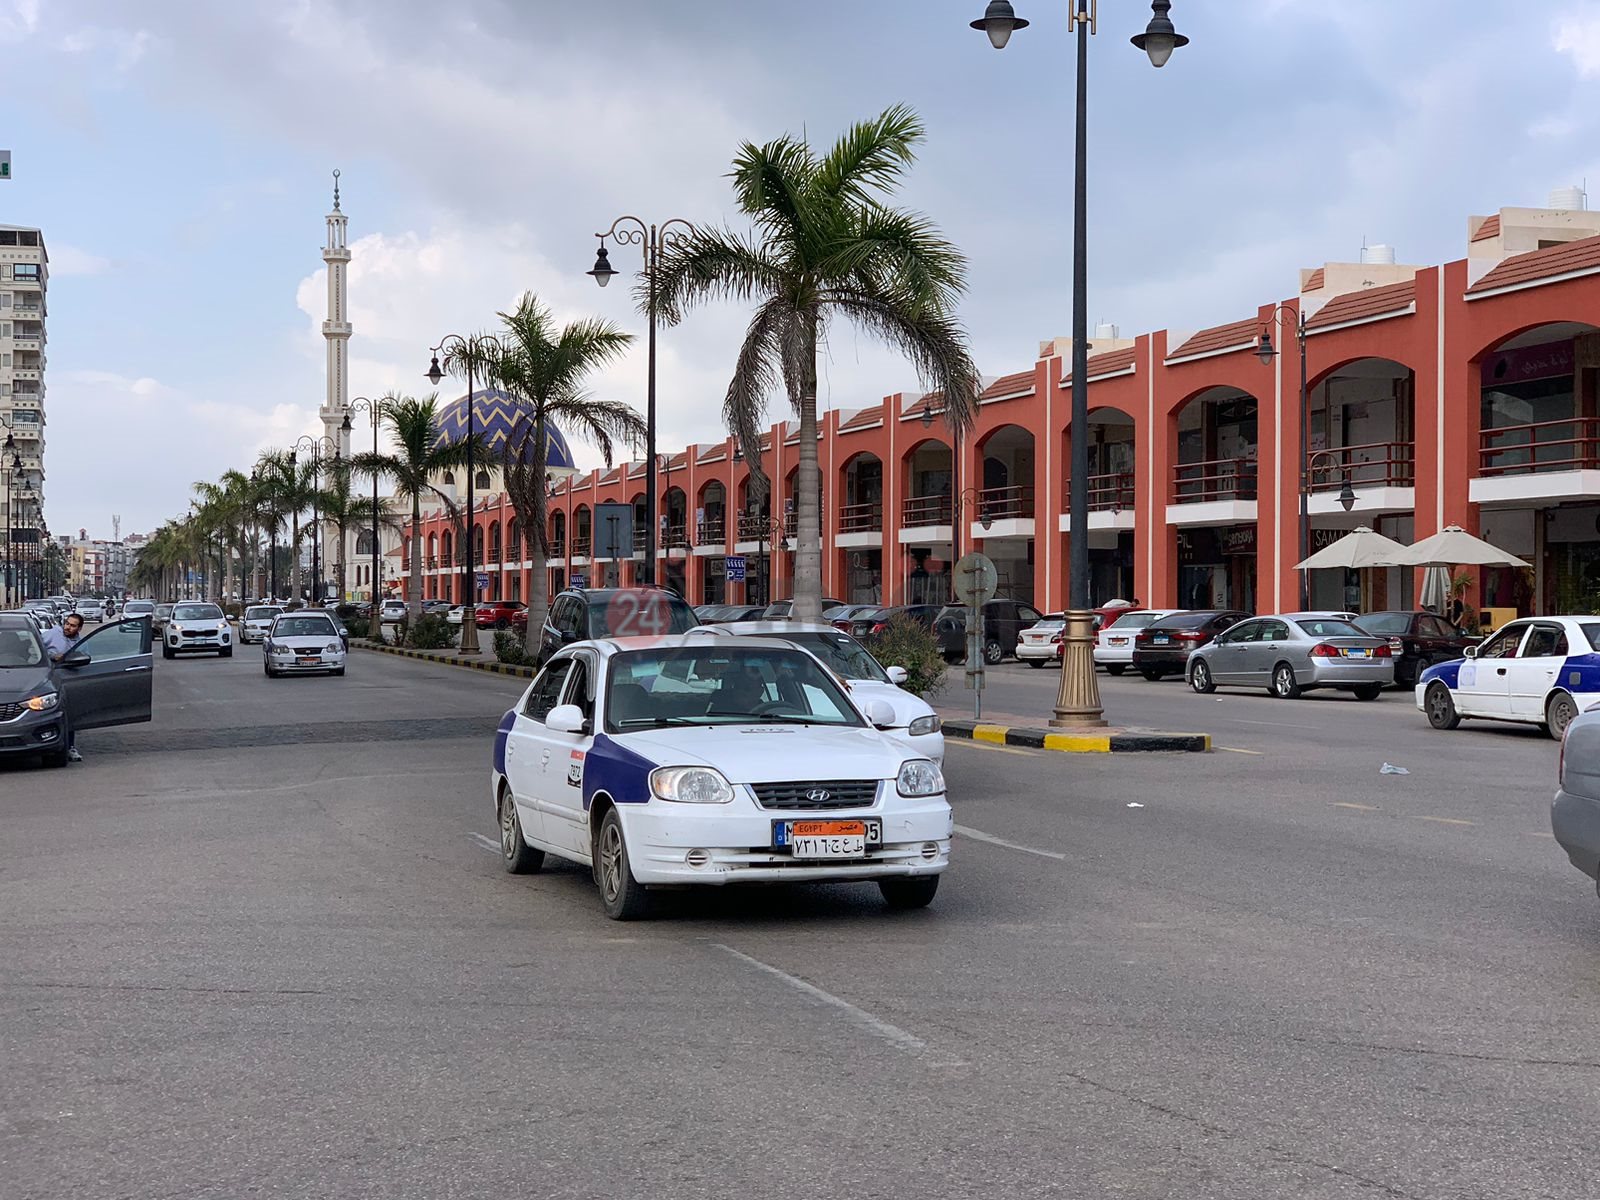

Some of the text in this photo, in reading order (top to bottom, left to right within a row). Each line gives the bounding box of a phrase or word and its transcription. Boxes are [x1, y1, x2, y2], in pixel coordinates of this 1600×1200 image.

[727, 570, 735, 580] P
[799, 824, 823, 833] EGYPT
[838, 824, 858, 833] مصر
